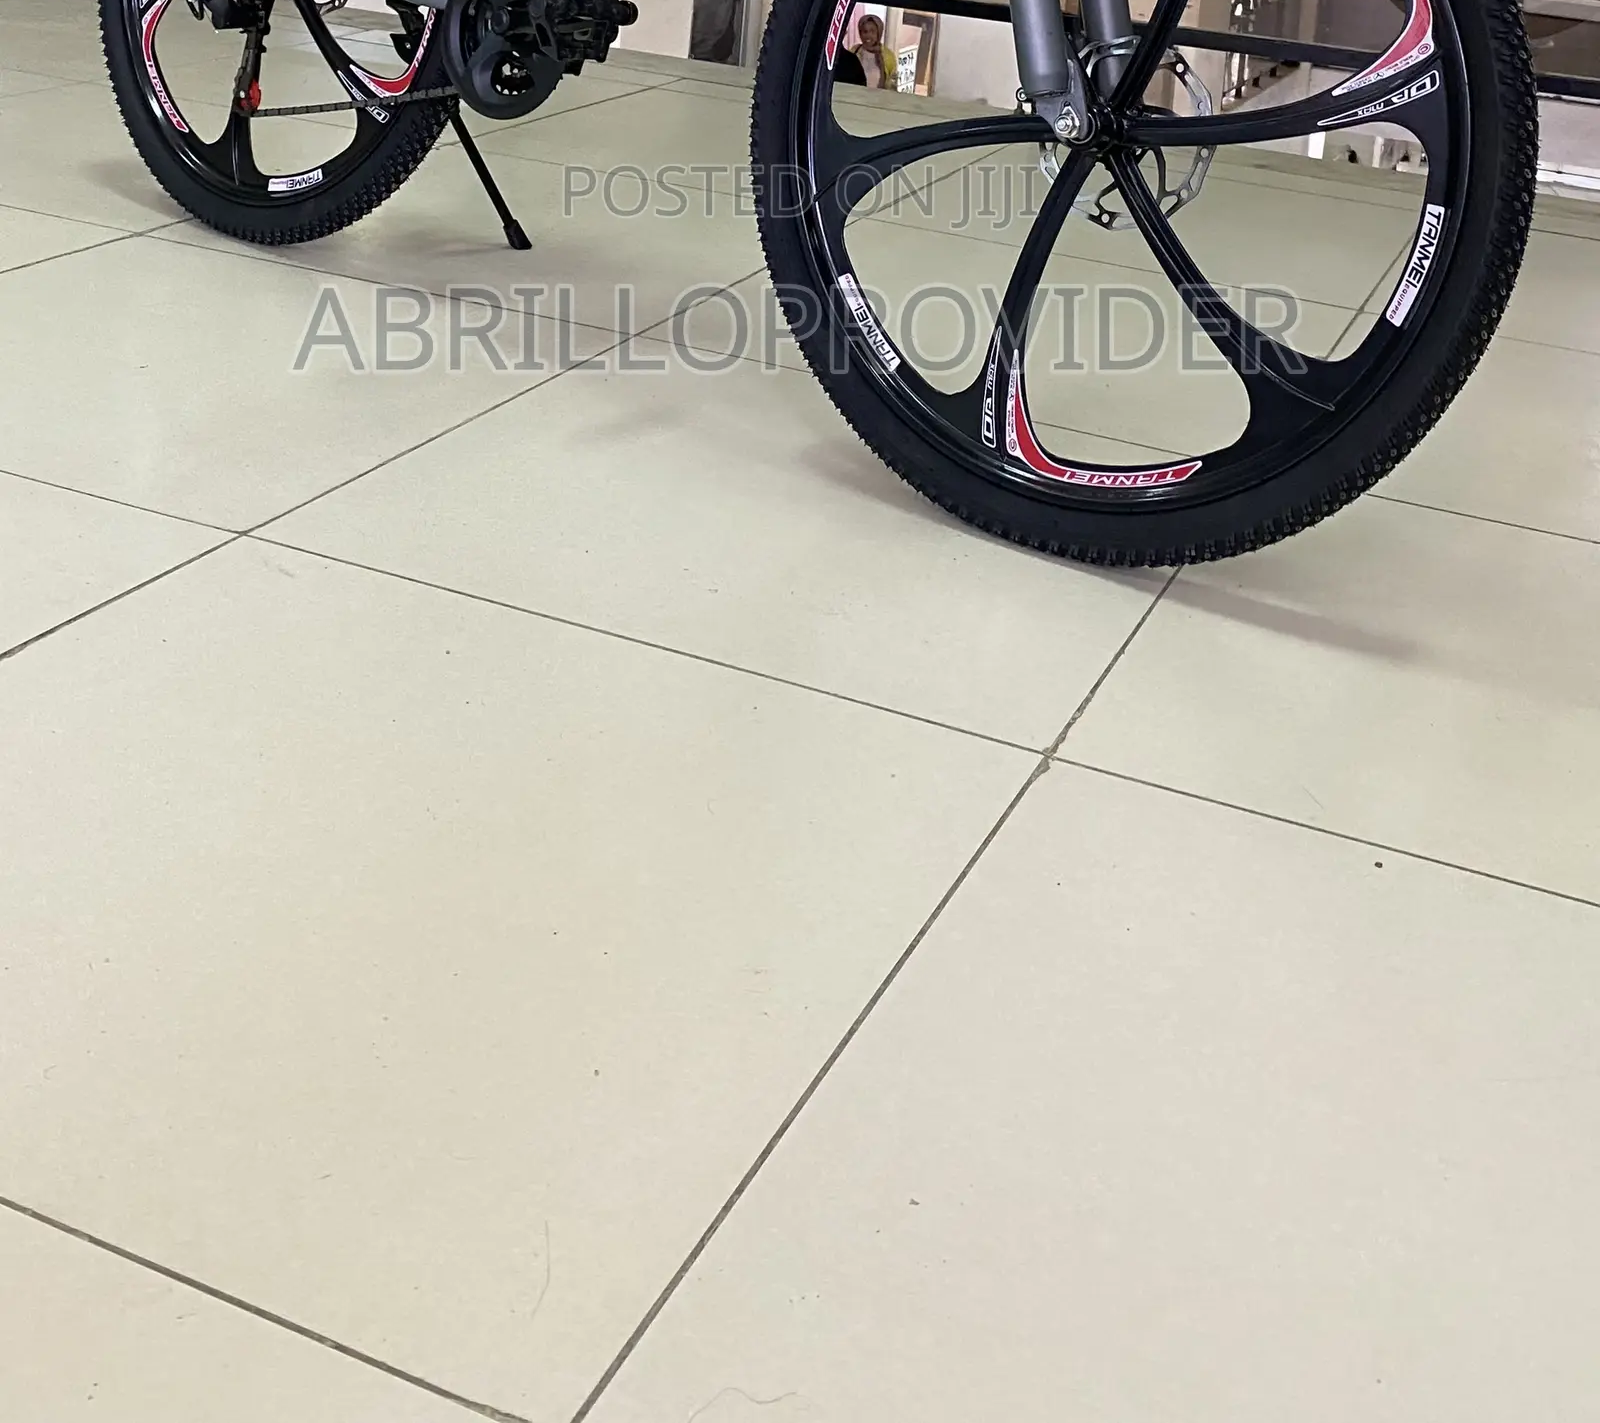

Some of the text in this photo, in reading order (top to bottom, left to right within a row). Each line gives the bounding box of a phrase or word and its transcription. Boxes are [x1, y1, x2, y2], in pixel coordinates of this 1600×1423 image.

[286, 171, 321, 188] TANMEI
[1388, 211, 1442, 321] TANMEI EQUIPPED
[854, 305, 897, 367] TANMEI
[1061, 470, 1177, 486] TANMEI
